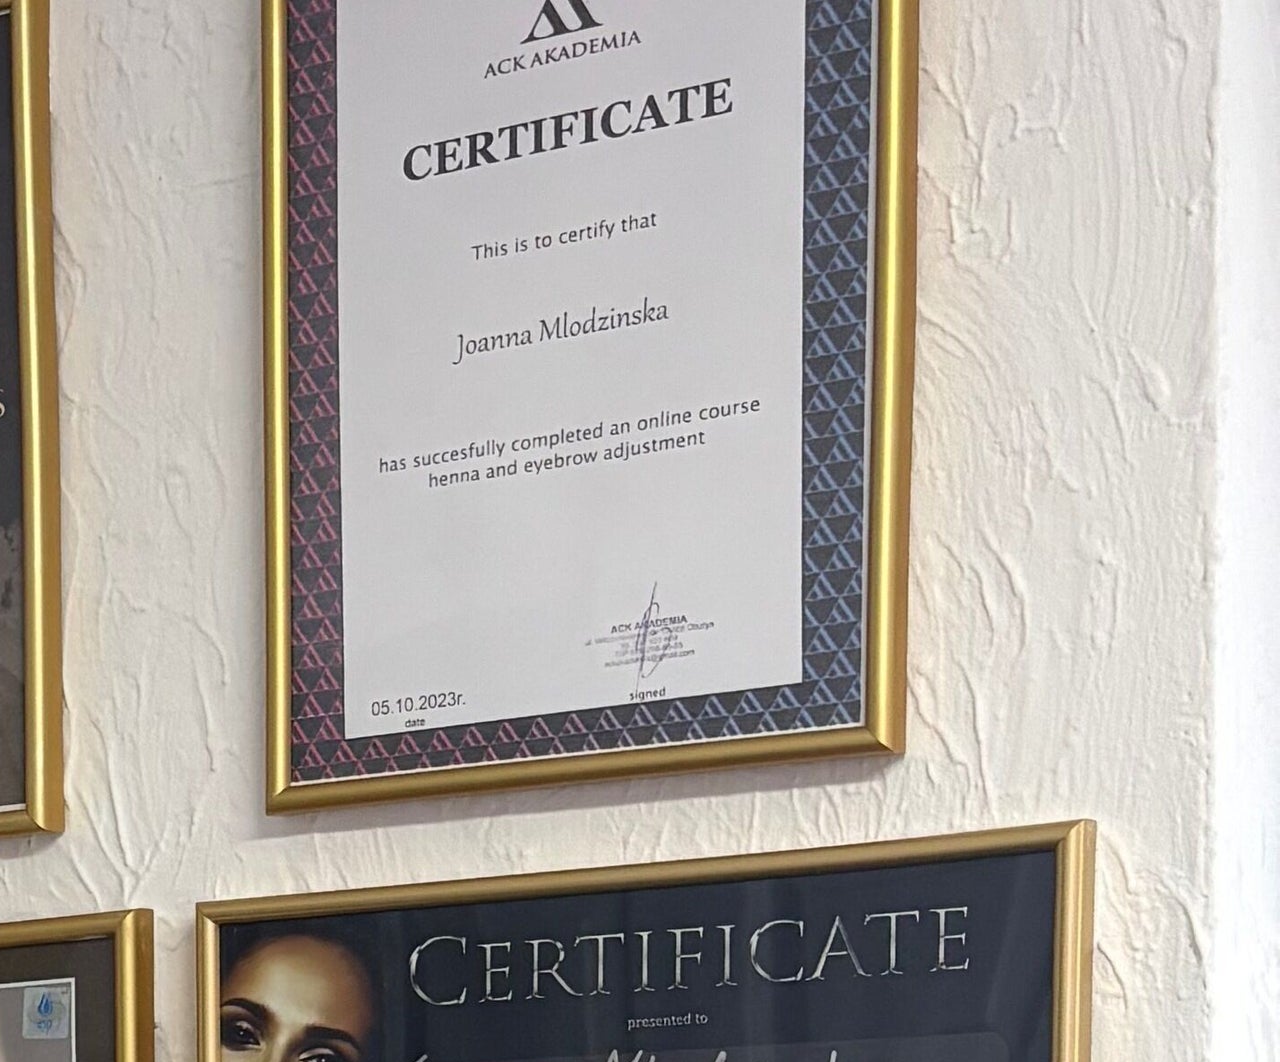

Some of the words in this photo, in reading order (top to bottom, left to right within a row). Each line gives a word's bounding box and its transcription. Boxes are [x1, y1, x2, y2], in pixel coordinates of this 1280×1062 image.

[484, 55, 526, 79] ACK
[530, 30, 642, 67] AKADEMIA
[402, 78, 733, 182] CERTIFICATE
[472, 241, 508, 261] This
[515, 238, 528, 253] is
[535, 233, 552, 248] to
[558, 220, 616, 245] certify
[621, 212, 657, 233] that
[452, 329, 533, 365] Joanna
[539, 298, 669, 341] Mlodzinska
[379, 457, 406, 473] has
[413, 440, 506, 468] succesfully
[511, 423, 604, 453] completed
[610, 421, 631, 436] an
[638, 408, 692, 431] online
[699, 399, 761, 422] course
[428, 470, 480, 488] henna
[486, 461, 518, 479] and
[524, 449, 598, 475] eyebrow
[603, 431, 705, 462] adjustment
[370, 691, 466, 716] 05.10.2023r.
[408, 906, 971, 1006] CERTIFICATE
[628, 1014, 691, 1031] presented
[696, 1012, 708, 1026] to
